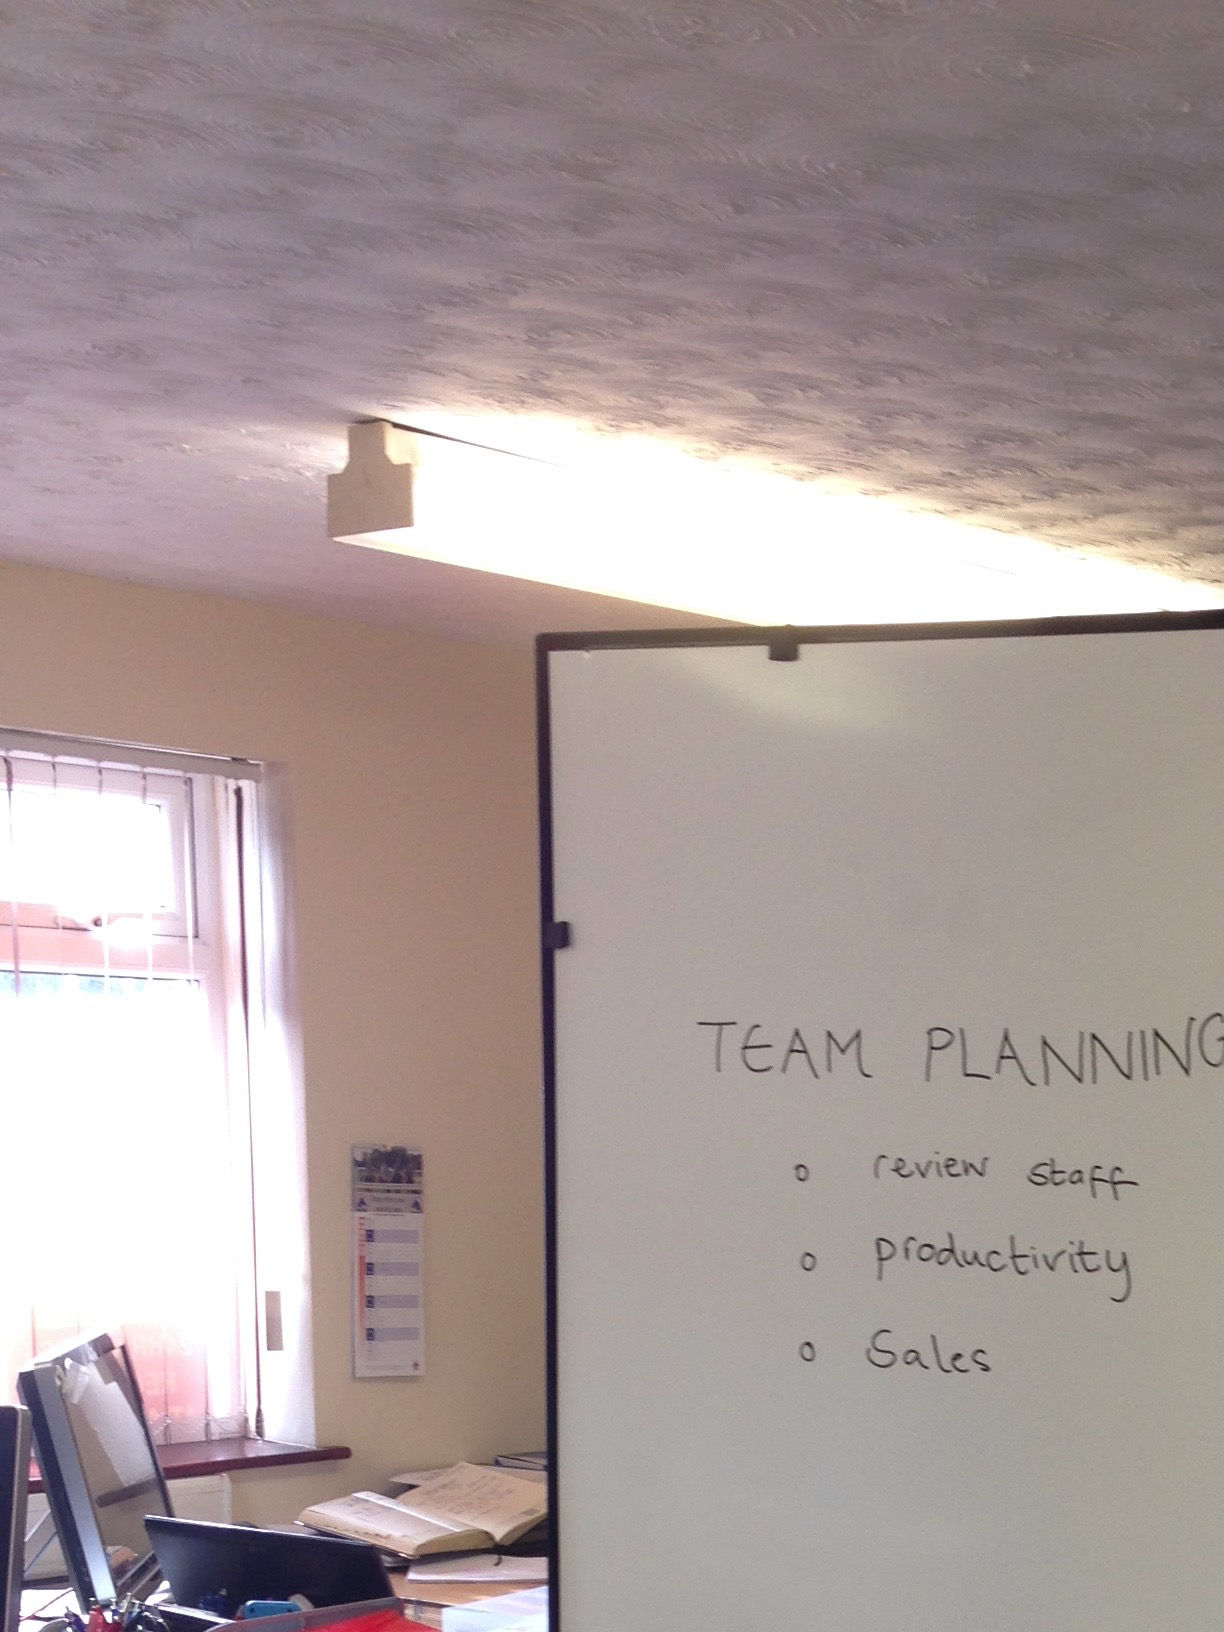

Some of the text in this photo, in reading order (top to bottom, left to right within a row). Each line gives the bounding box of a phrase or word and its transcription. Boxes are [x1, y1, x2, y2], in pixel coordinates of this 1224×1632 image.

[696, 1020, 874, 1080] TEAM
[872, 1151, 1140, 1201] review staff
[874, 1232, 1133, 1304] productivity
